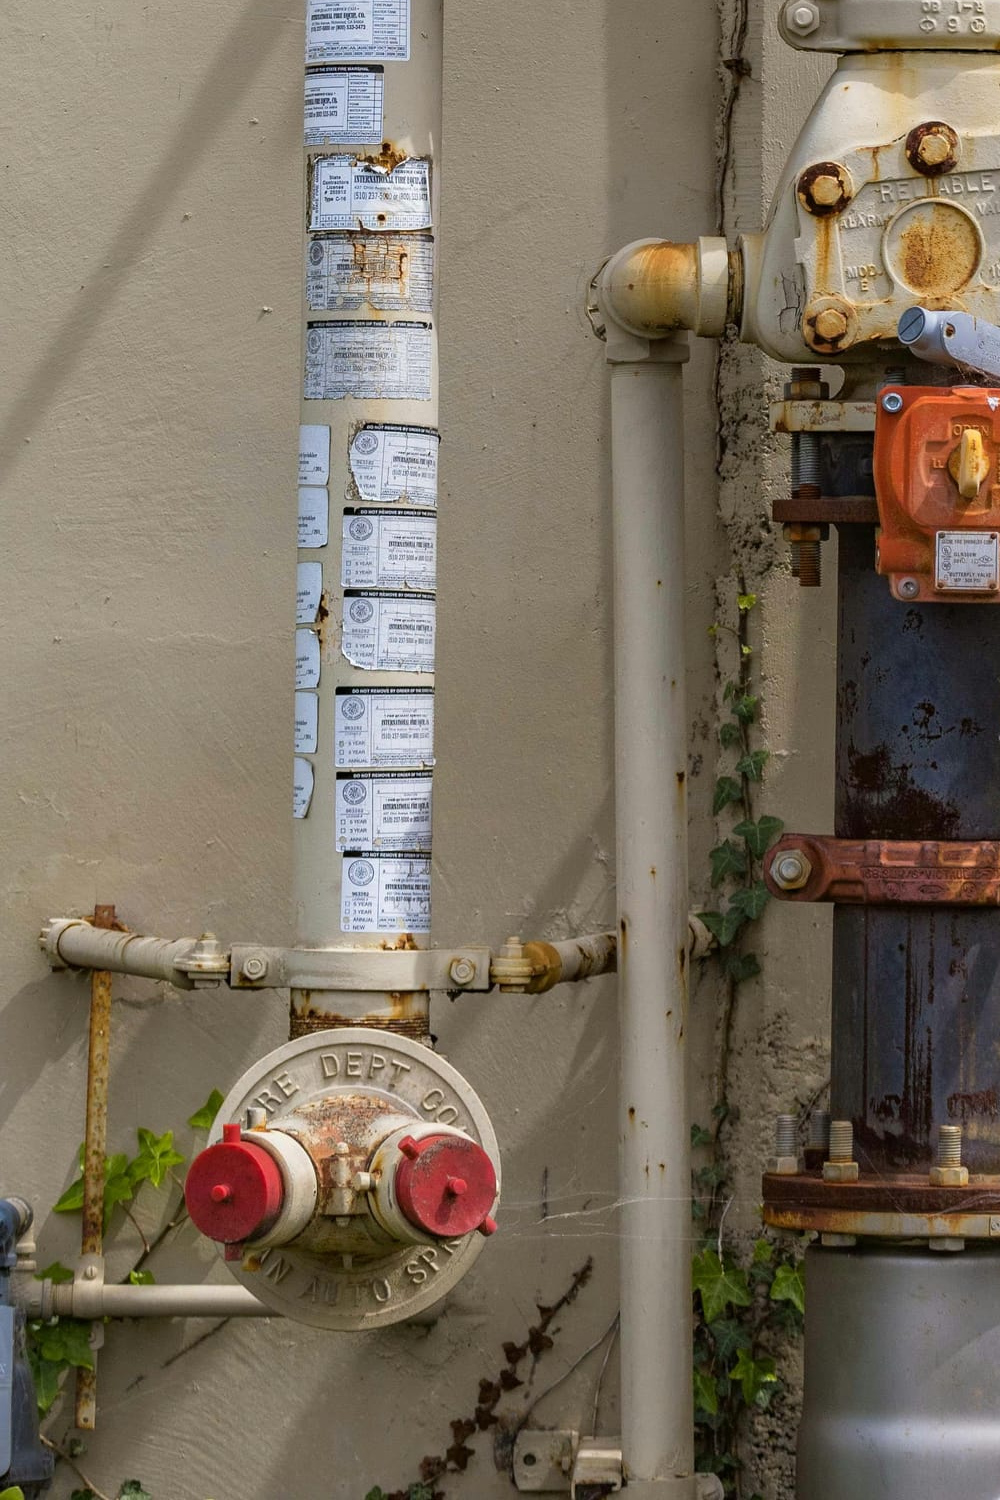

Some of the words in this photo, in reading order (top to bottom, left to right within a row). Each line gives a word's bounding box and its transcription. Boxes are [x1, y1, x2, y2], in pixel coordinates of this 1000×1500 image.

[354, 175, 394, 184] INTERNATIONAL
[320, 1051, 411, 1086] DEPT
[301, 1275, 393, 1307] AUTO
